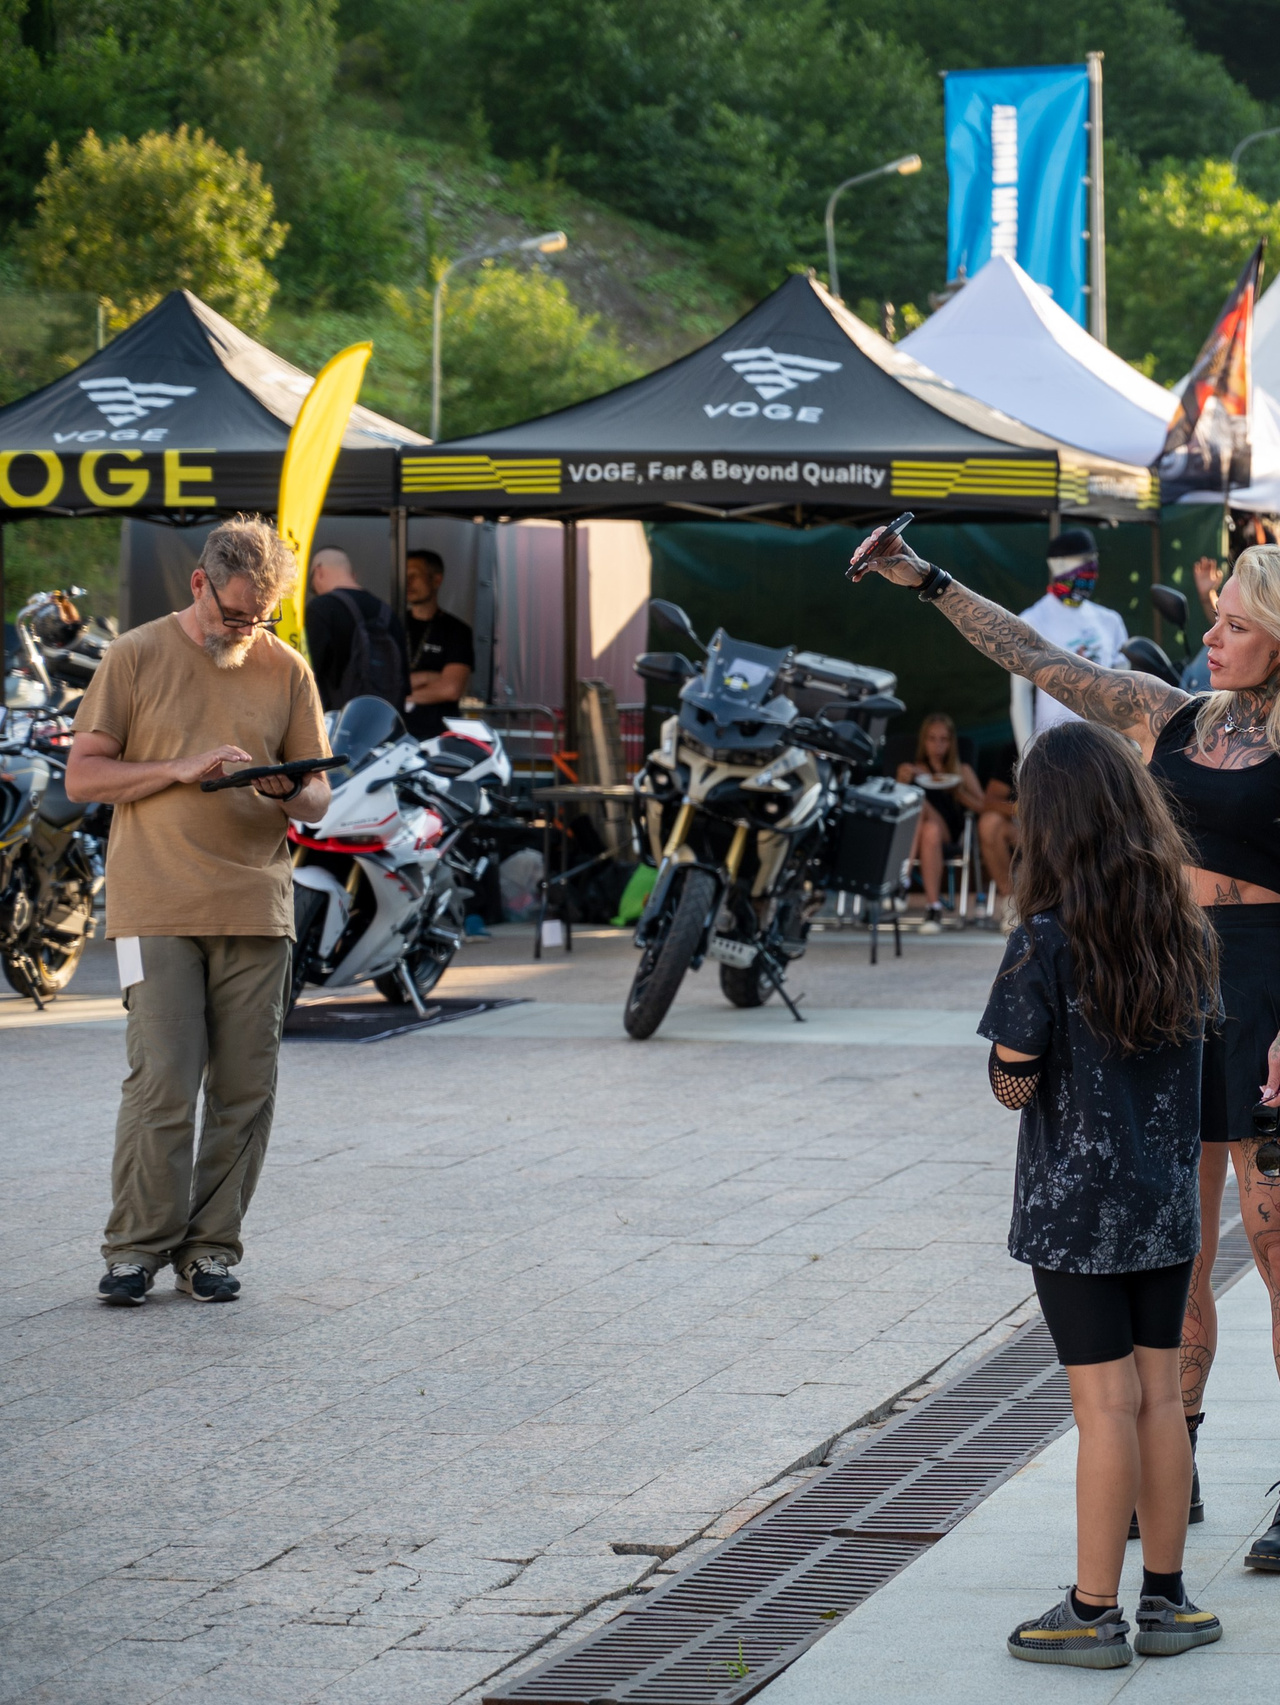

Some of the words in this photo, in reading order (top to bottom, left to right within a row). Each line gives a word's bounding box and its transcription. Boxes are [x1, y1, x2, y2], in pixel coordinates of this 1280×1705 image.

[702, 401, 824, 423] VOGE
[52, 427, 169, 444] VOGE
[568, 462, 644, 484] VOGE,
[648, 461, 687, 481] Far
[690, 460, 708, 480] &
[711, 459, 799, 484] Beyond
[802, 461, 886, 488] Quality
